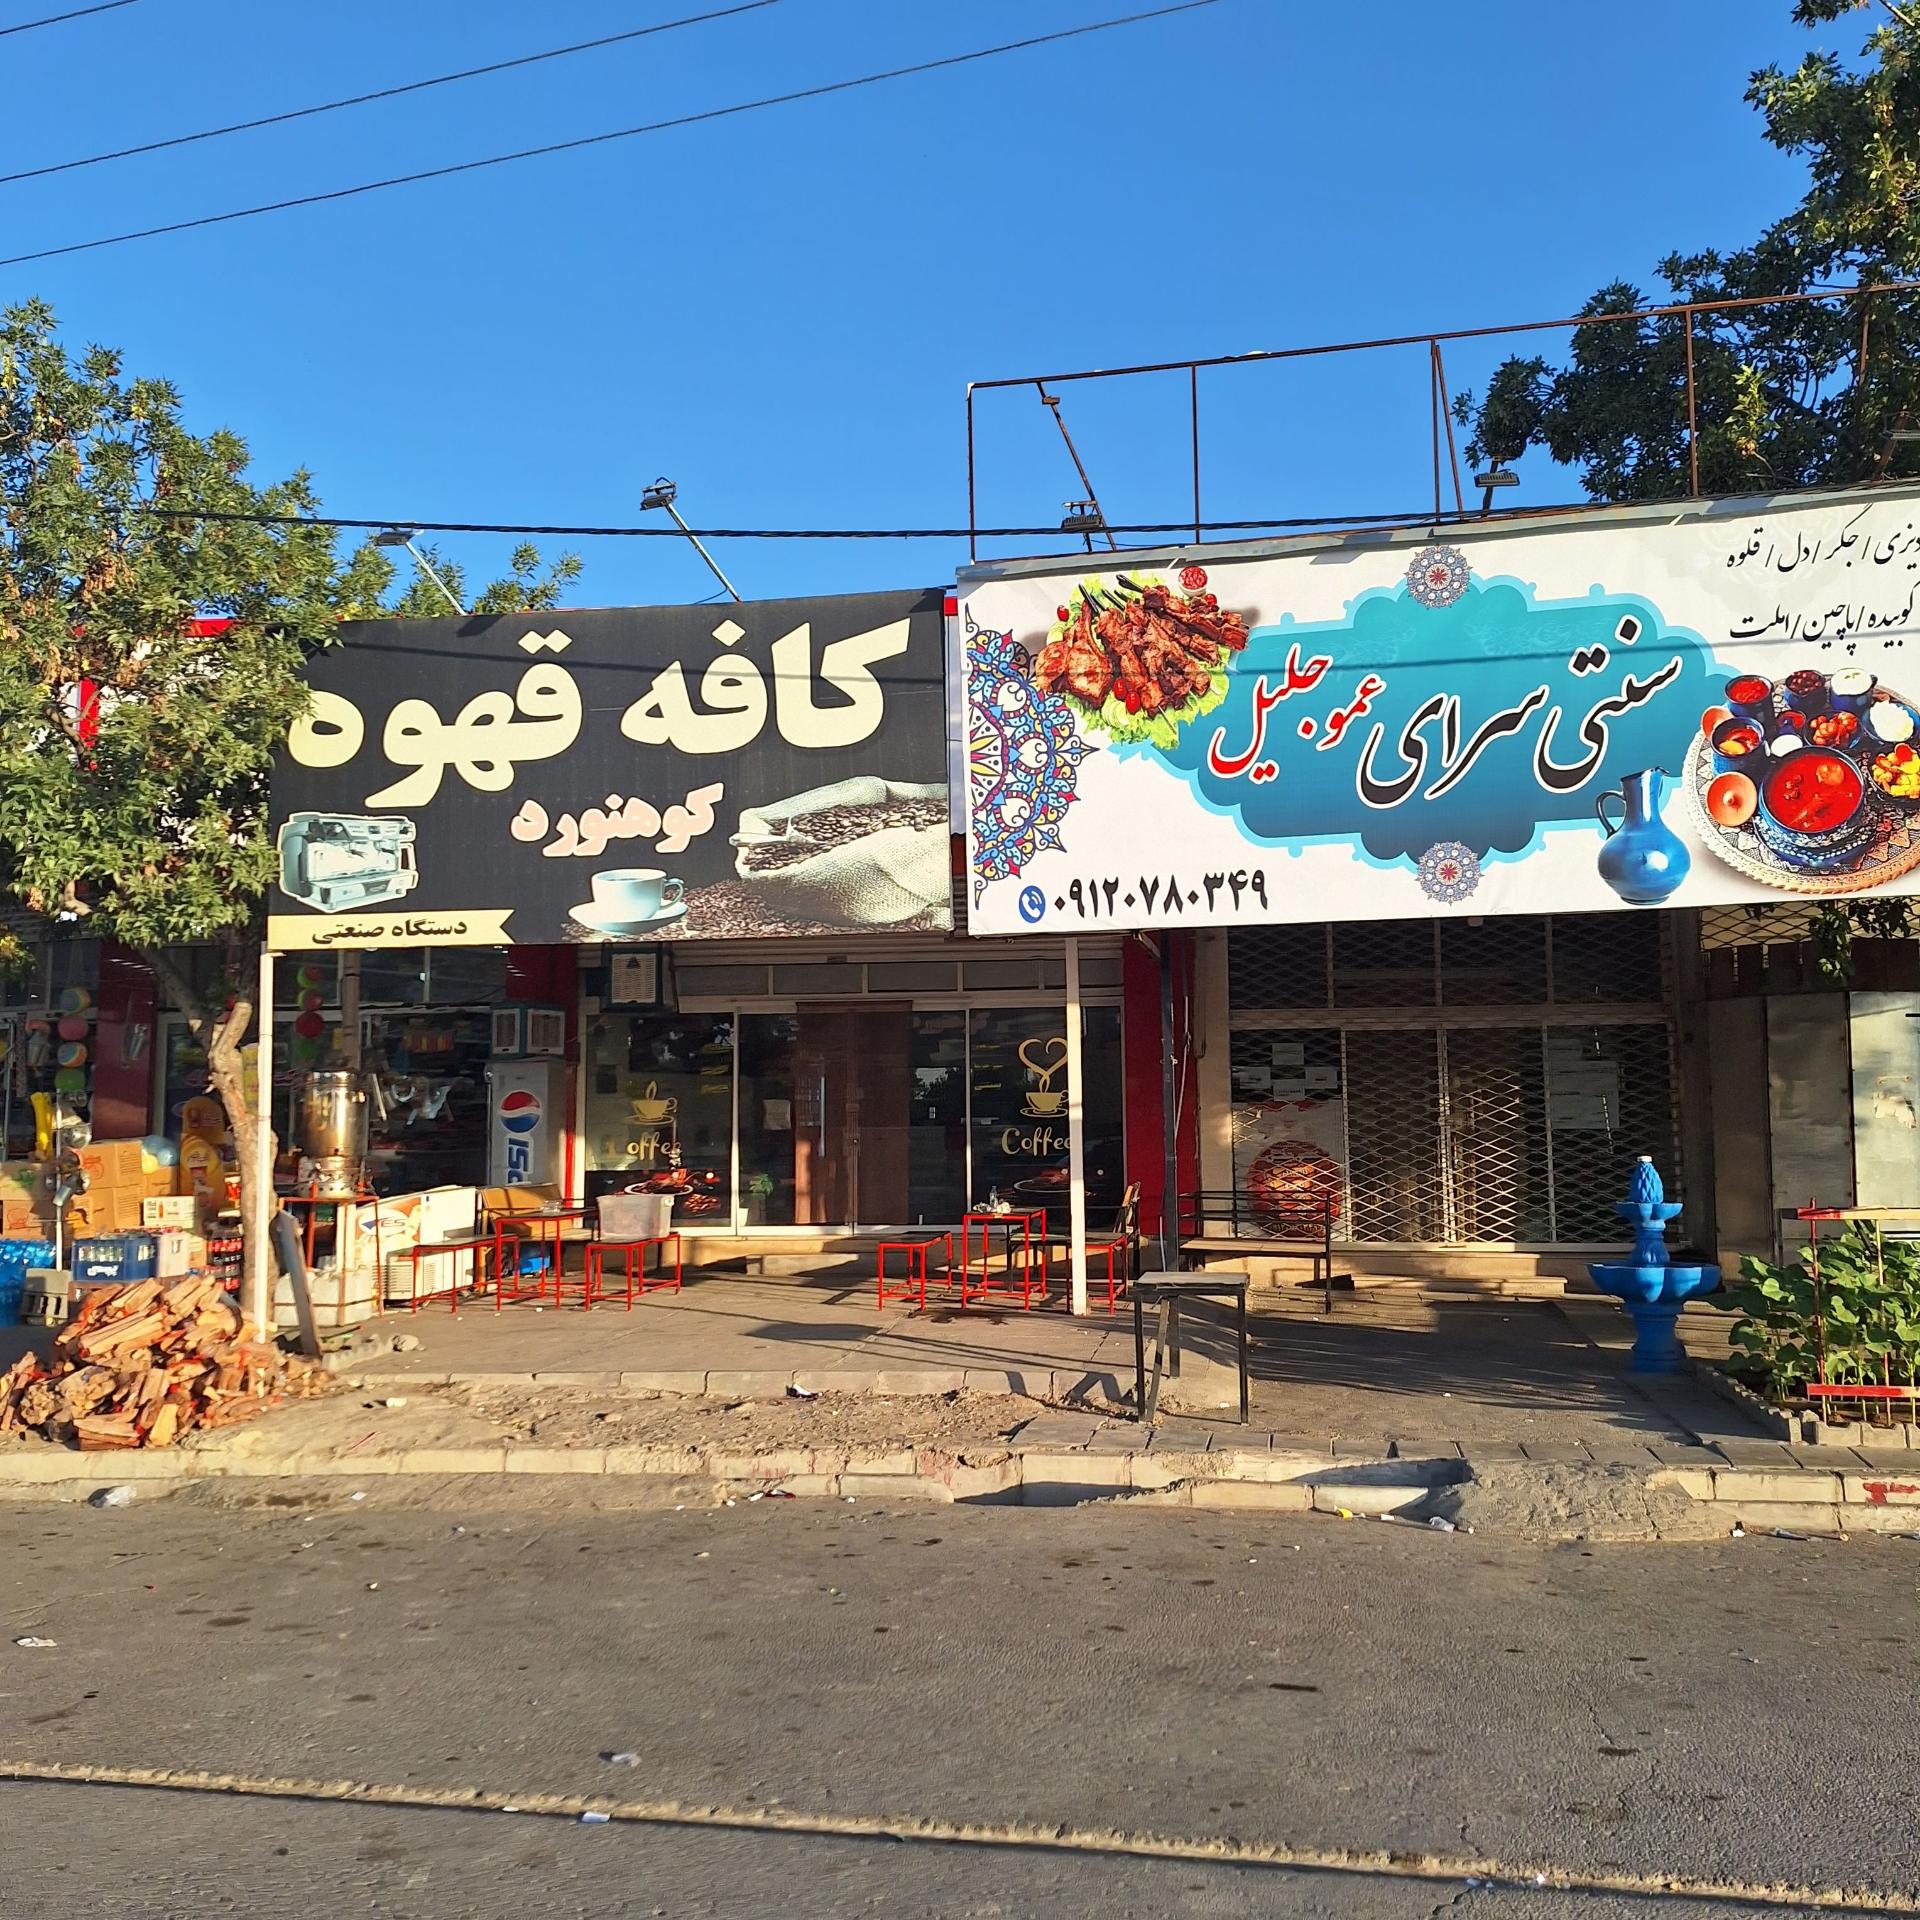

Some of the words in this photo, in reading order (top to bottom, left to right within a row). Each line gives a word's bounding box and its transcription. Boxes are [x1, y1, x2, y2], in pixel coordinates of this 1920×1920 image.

[1727, 527, 1764, 567] قلوه
[1778, 531, 1810, 572] دل
[1730, 604, 1790, 638] املت
[620, 617, 912, 757] کافه
[1207, 644, 1332, 784] جلیل
[1535, 614, 1682, 793] سنتی
[287, 628, 583, 809] قهوه
[1357, 685, 1549, 808] سرای
[511, 782, 725, 858] کوهنورد
[1054, 868, 1269, 917] ۰۹۱۲۰۷۸۰۳۴۹
[311, 922, 386, 945] صنعتی
[391, 918, 467, 939] دستگاه
